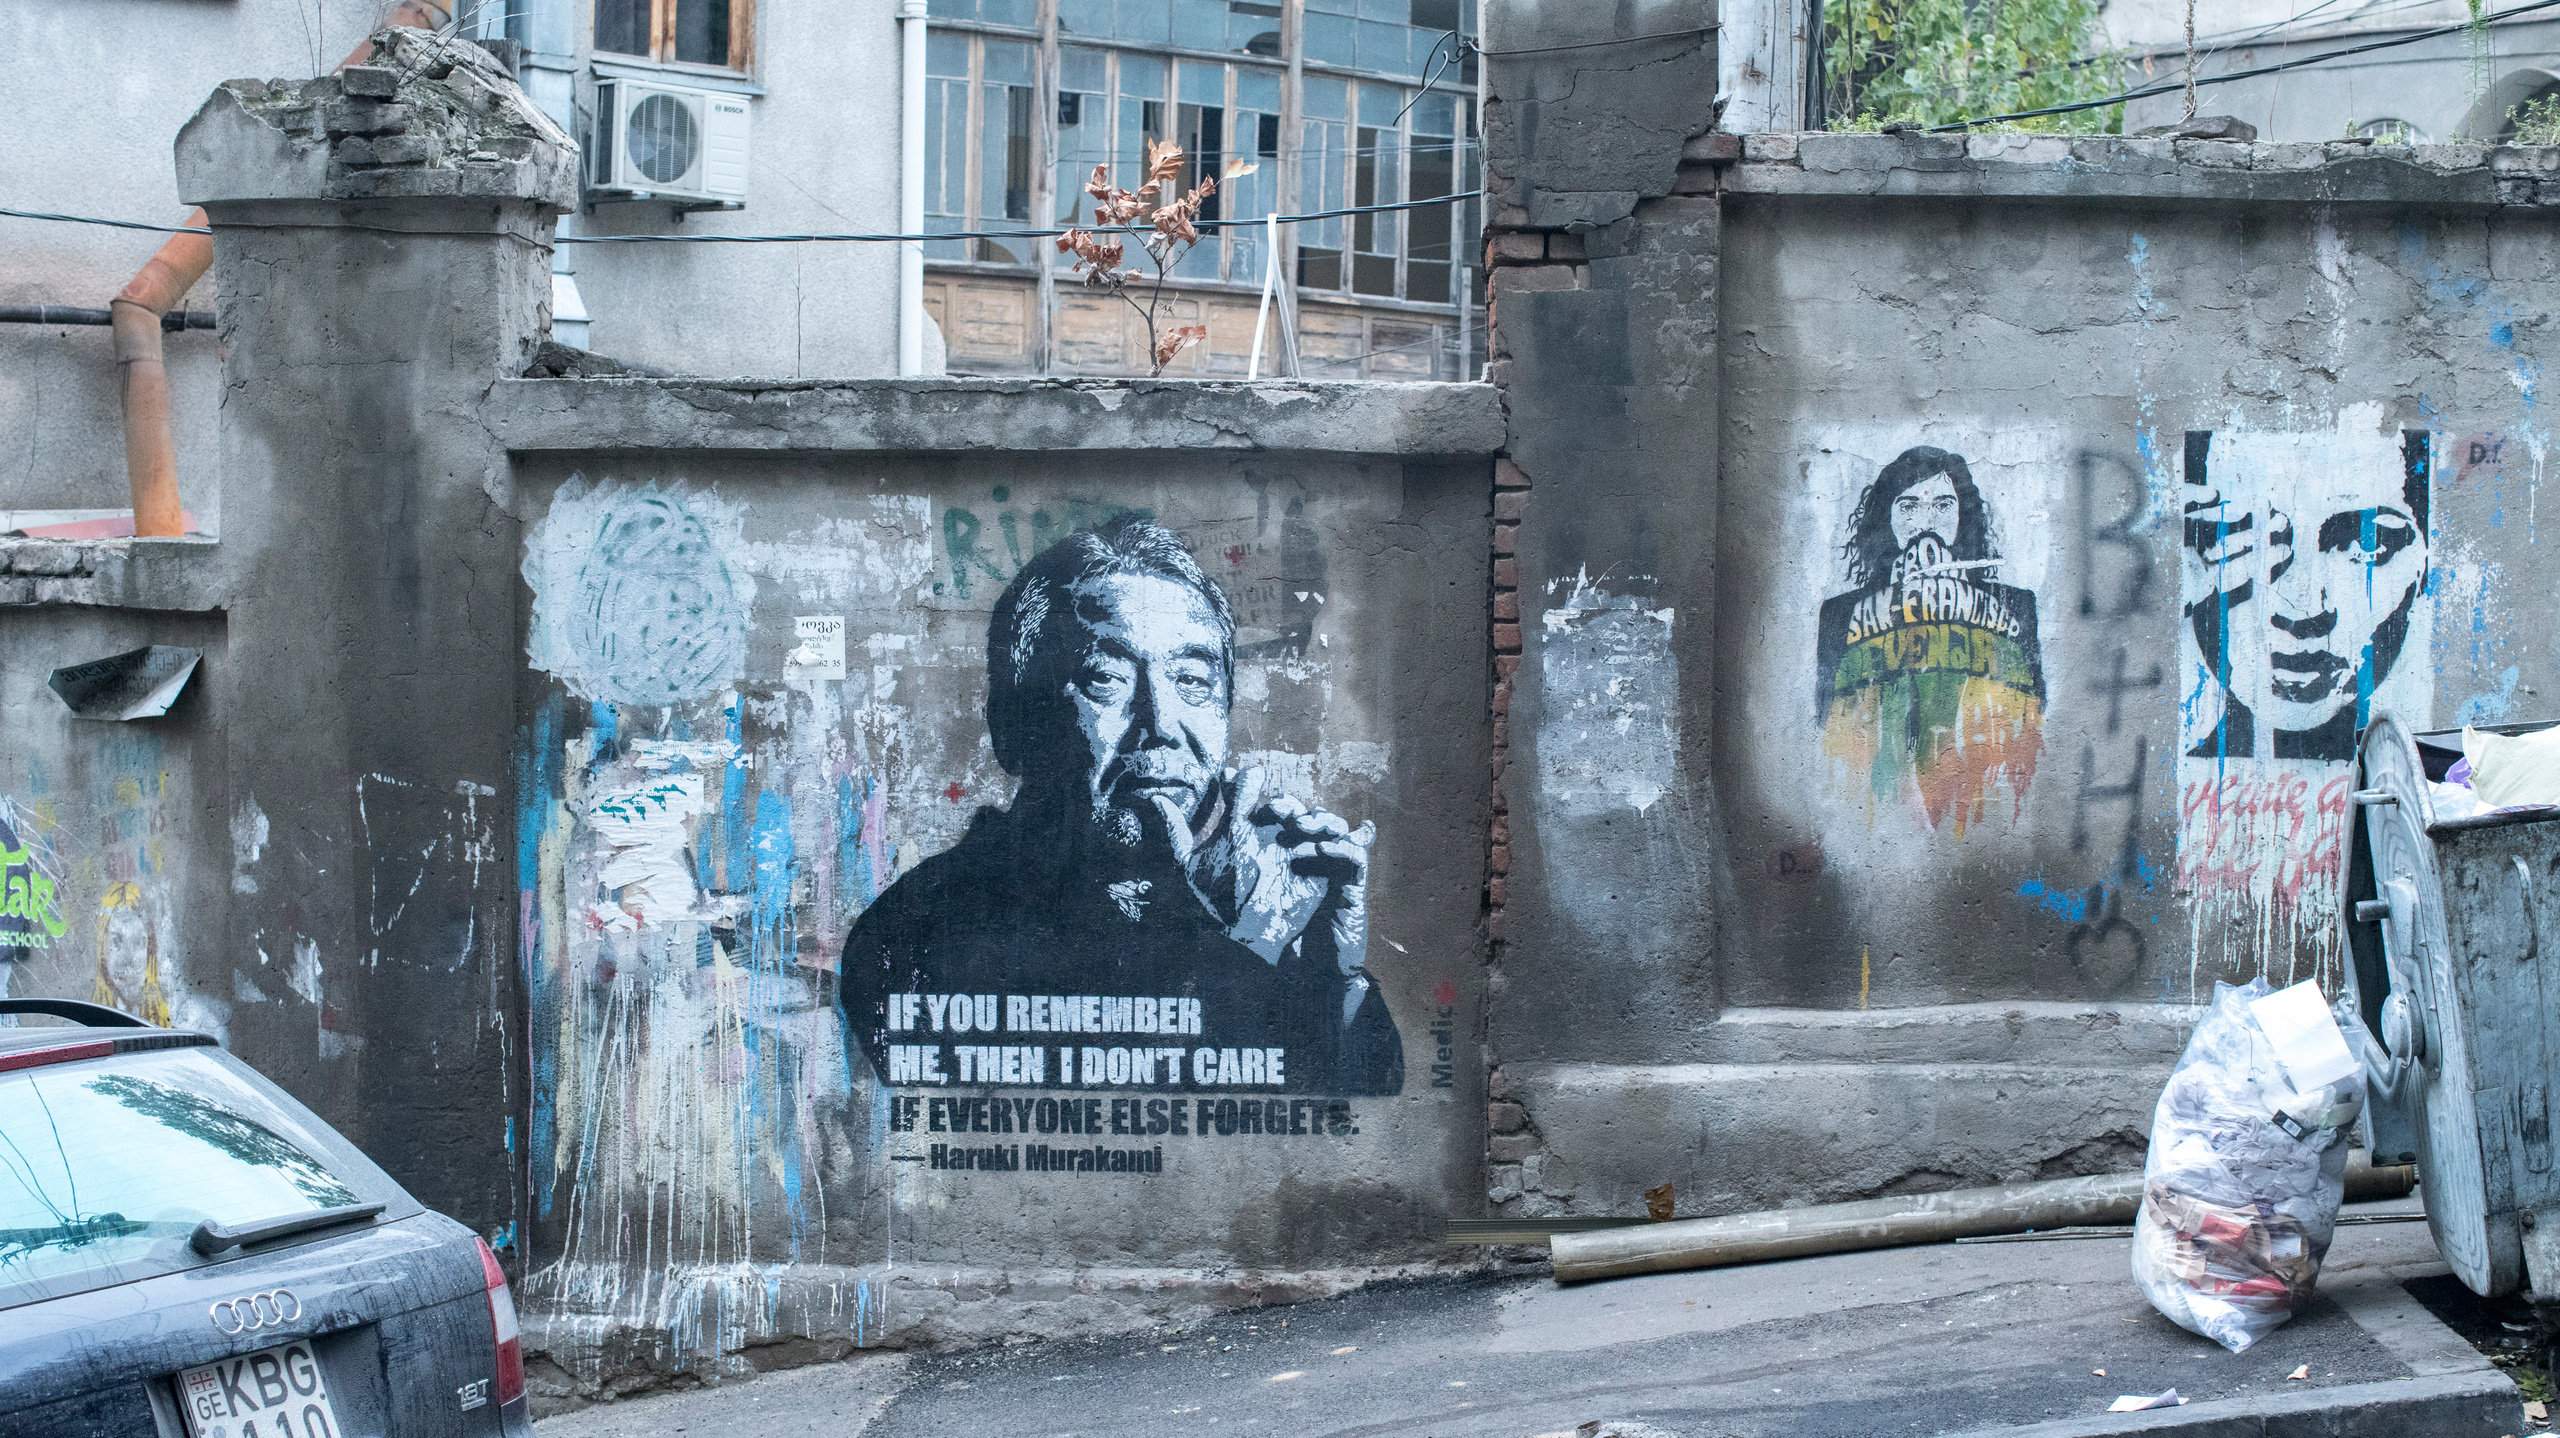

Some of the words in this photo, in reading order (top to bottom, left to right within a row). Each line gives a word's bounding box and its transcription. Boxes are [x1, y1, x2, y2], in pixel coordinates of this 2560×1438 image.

[724, 106, 744, 114] BOSCH
[801, 621, 841, 634] ოვკა
[889, 993, 921, 1030] IF
[926, 993, 998, 1032] YOU
[1006, 994, 1202, 1035] REMEMBER
[889, 1045, 948, 1085] ME,
[954, 1045, 1044, 1083] THEN
[1061, 1046, 1073, 1084] I
[1081, 1046, 1186, 1085] DON'T
[1193, 1047, 1285, 1085] CARE
[1431, 1004, 1454, 1088] Medic
[890, 1096, 921, 1132] IF
[929, 1096, 1103, 1134] EVERYONE
[1111, 1098, 1189, 1136] ELSE
[930, 1143, 1019, 1172] Haruki
[1026, 1143, 1163, 1173] Murakami
[216, 1346, 317, 1418] KBG
[196, 1391, 227, 1420] GE
